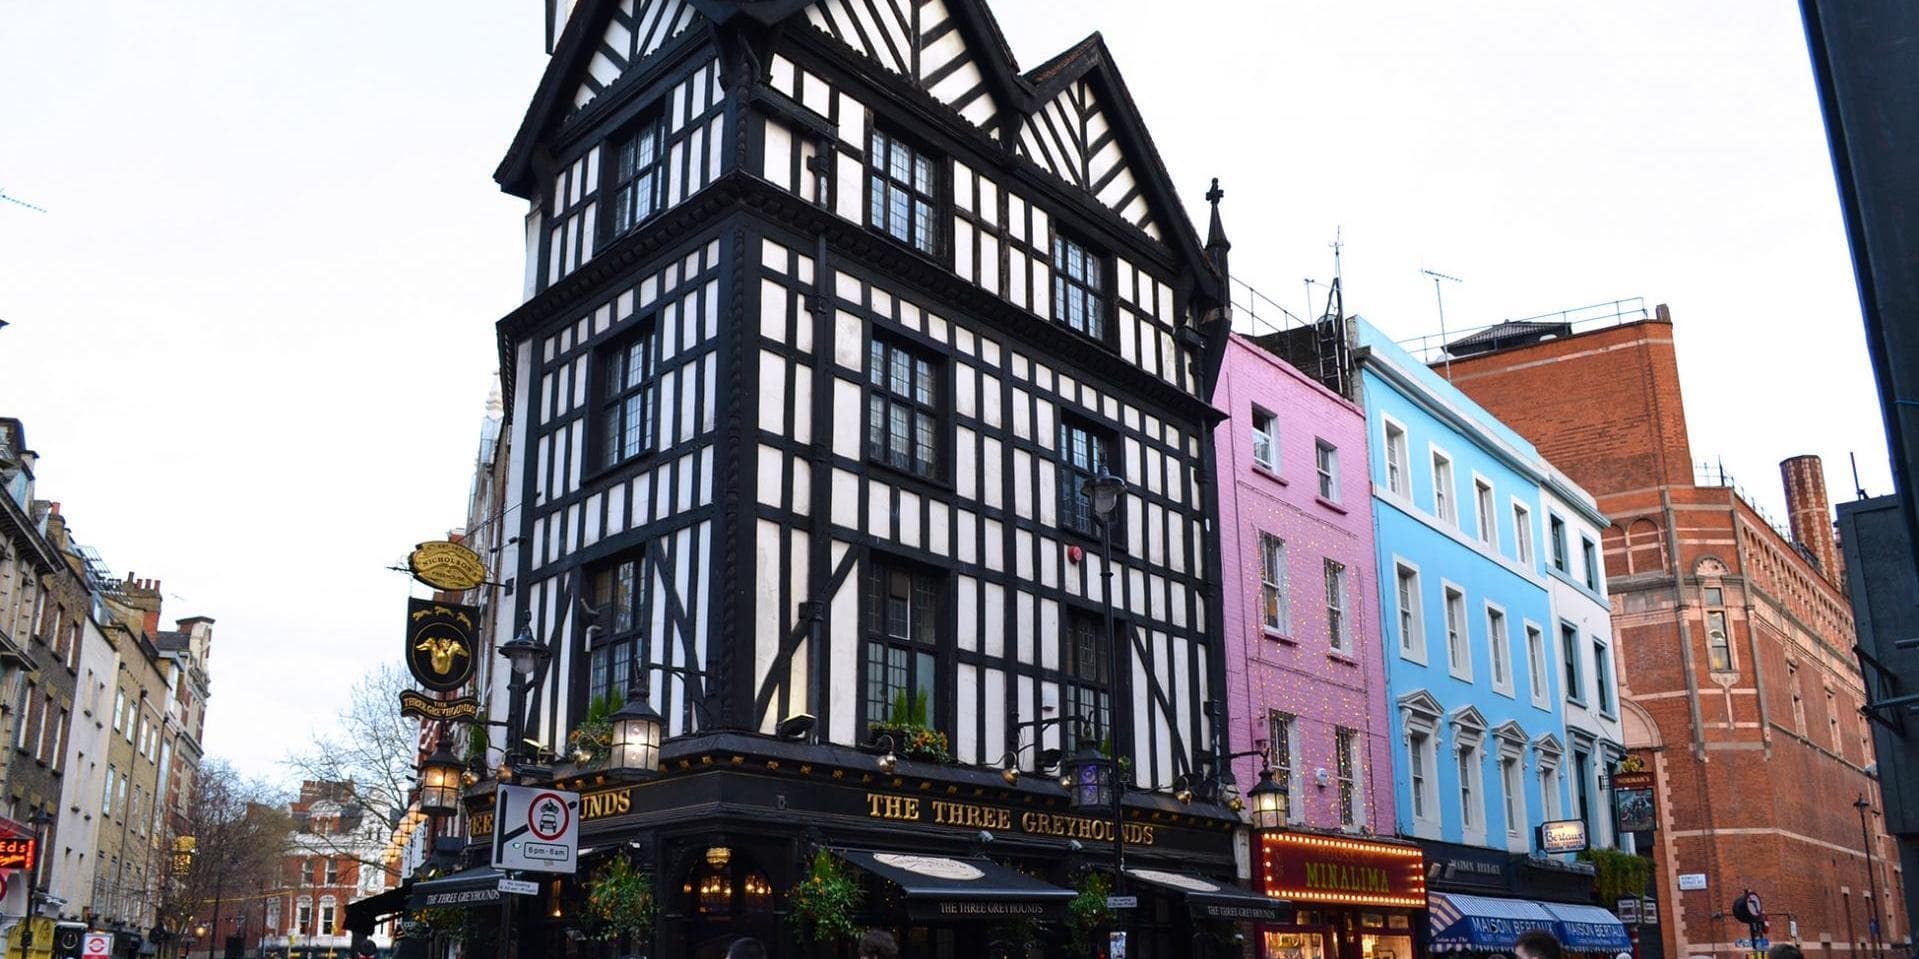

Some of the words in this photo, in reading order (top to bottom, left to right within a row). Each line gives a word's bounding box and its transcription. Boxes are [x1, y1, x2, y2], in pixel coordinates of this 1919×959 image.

[867, 793, 920, 820] THE
[932, 801, 1010, 829] THREE
[1304, 862, 1390, 893] MINALIMA
[940, 902, 958, 914] THE
[960, 902, 987, 914] THREE
[988, 902, 1044, 914] GREYHOUNDS
[1471, 916, 1513, 935] MAISON
[1564, 921, 1595, 936] MAISON
[1594, 923, 1626, 938] BERTAUX
